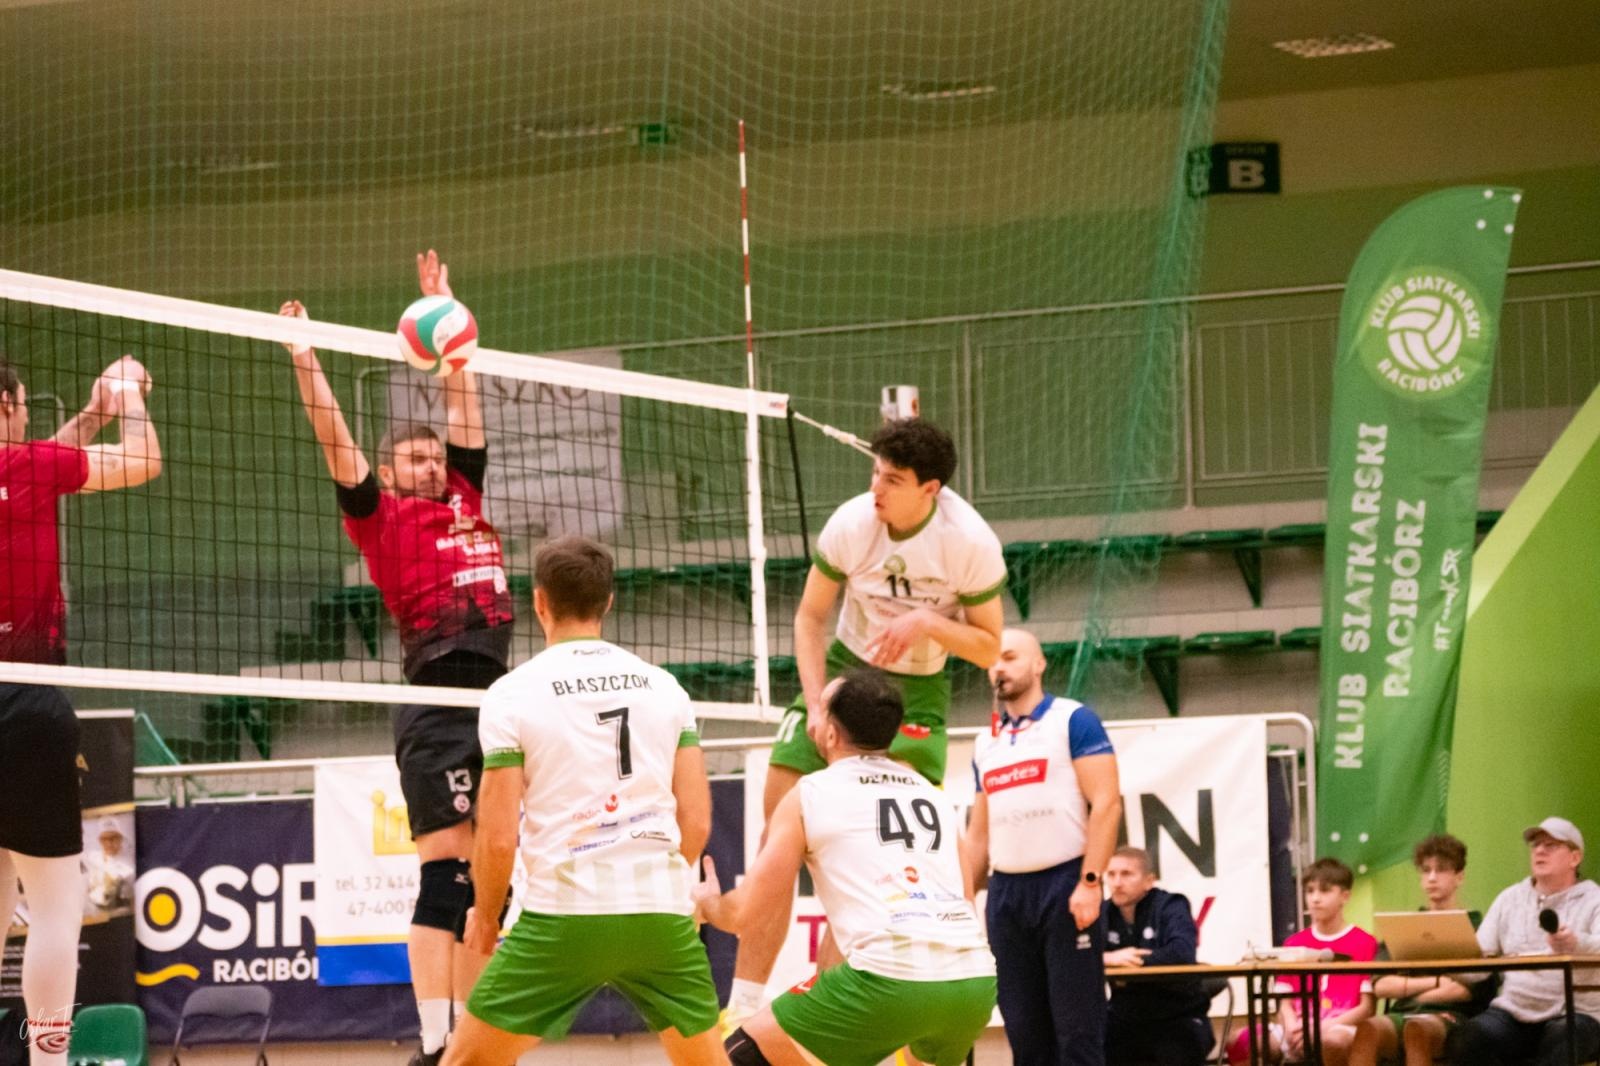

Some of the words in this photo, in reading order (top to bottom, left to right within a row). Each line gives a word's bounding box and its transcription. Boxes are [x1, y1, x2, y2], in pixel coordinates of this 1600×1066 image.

[1228, 160, 1265, 188] B
[1370, 284, 1405, 329] KLUB
[1406, 276, 1481, 339] SIATKARSKI
[1376, 358, 1465, 392] RACIBÓRZ
[1341, 422, 1388, 653] SIATKARSKI
[1383, 498, 1426, 697] RACIBÓRZ
[552, 674, 653, 696] BŁASZCZOK
[594, 707, 632, 780] 7
[1334, 673, 1368, 769] KLUB
[877, 798, 941, 853] 49
[134, 862, 316, 952] OSiR
[347, 899, 405, 917] 47-400
